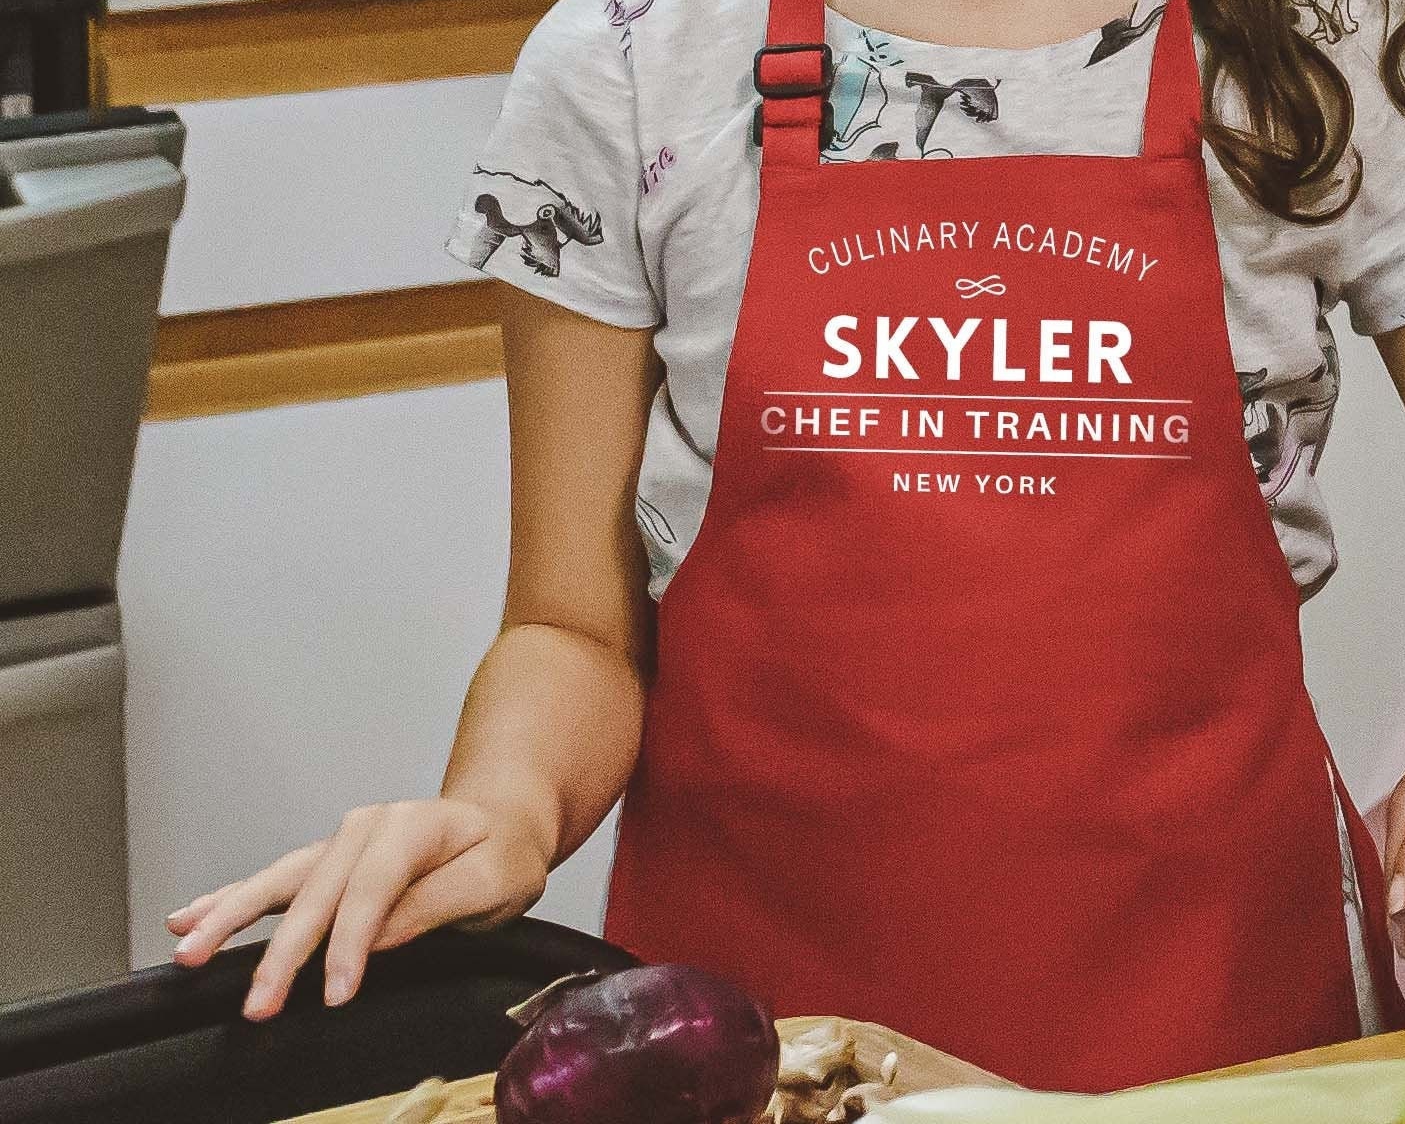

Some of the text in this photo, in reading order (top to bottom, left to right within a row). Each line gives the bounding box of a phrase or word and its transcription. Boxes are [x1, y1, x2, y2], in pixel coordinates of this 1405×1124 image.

[808, 221, 1159, 282] CULINARY ACADEMY
[822, 314, 1133, 384] SKYLER
[760, 406, 1190, 444] CHEF IN TRAINING
[893, 472, 1057, 495] NEW YORK
